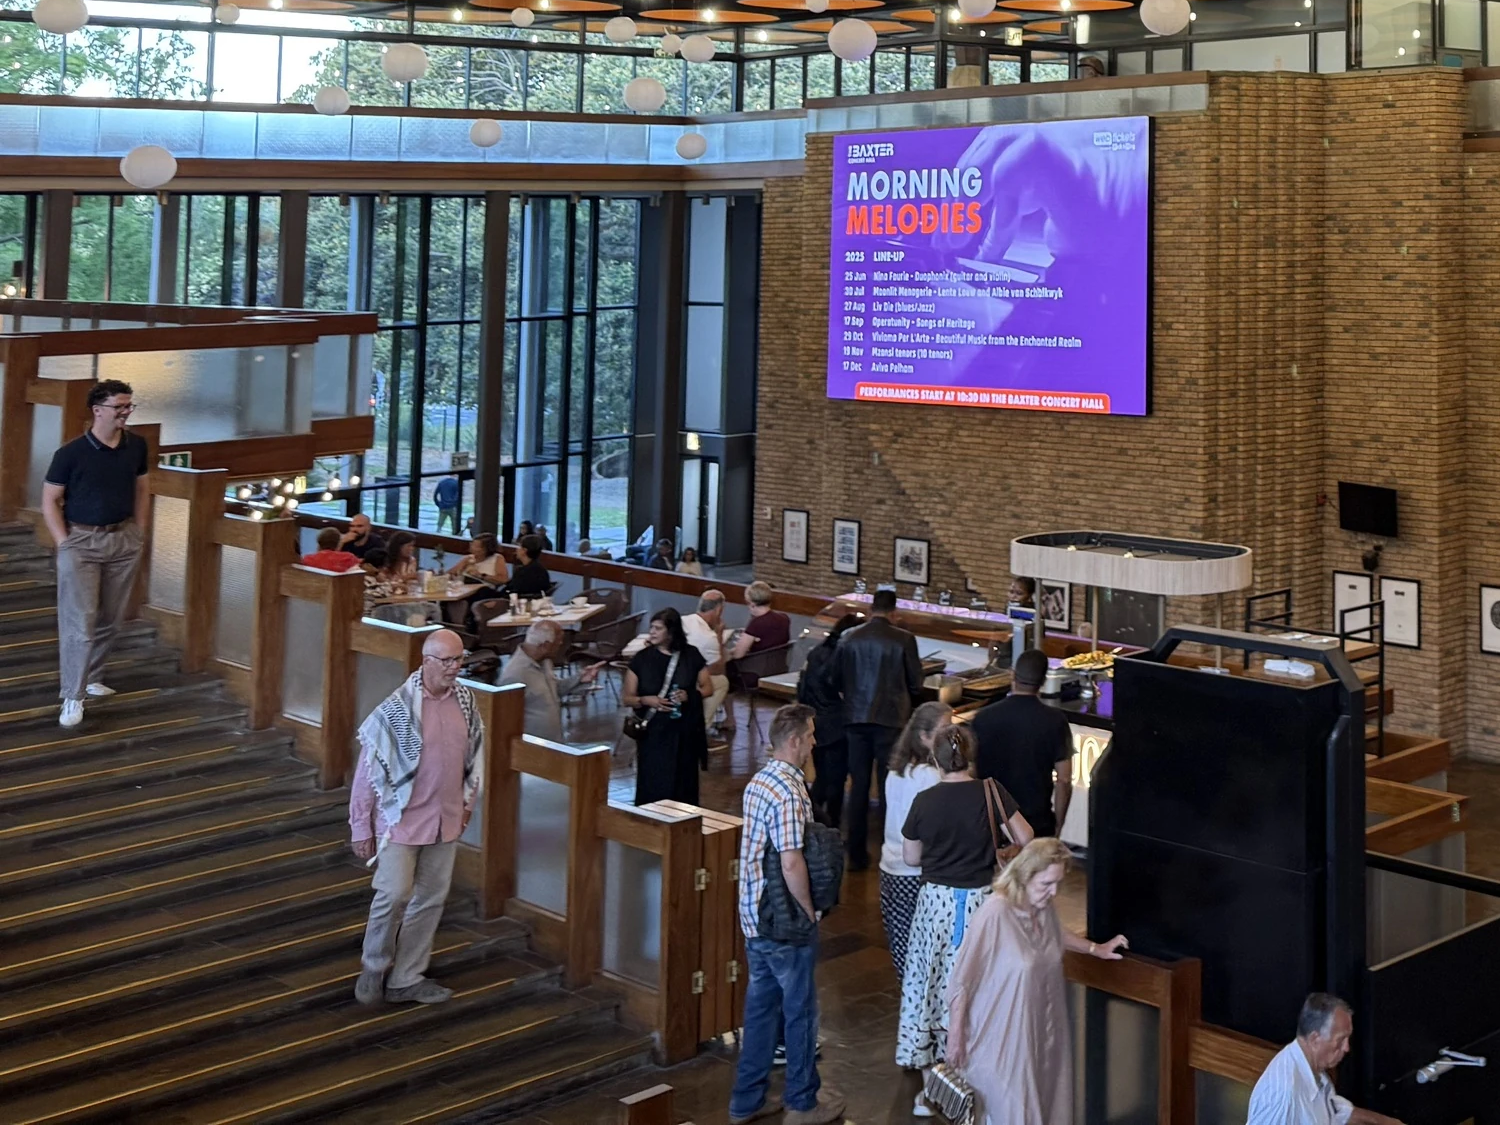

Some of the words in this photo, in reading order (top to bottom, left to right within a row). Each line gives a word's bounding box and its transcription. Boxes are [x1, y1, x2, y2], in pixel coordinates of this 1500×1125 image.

[852, 143, 894, 158] BAXTER
[847, 167, 982, 201] MORNING
[846, 201, 982, 235] MELODIES
[845, 251, 865, 262] 2025
[873, 251, 905, 262] LINE-UP
[845, 271, 854, 281] 25
[854, 271, 866, 281] Jun
[889, 271, 909, 281] Fourie
[975, 271, 988, 282] and
[854, 286, 865, 296] Jul
[873, 286, 897, 296] Moonlit
[898, 286, 932, 298] Menagerie
[977, 287, 991, 297] and
[992, 286, 1009, 297] Albie
[1010, 288, 1024, 298] van
[844, 301, 853, 311] 27
[853, 301, 865, 313] Aug
[872, 301, 882, 311] Liv
[844, 316, 851, 326] 17
[851, 316, 864, 327] Sep
[916, 317, 936, 329] Songs
[937, 317, 946, 327] of
[946, 318, 976, 330] Heritage
[852, 331, 863, 341] Oct
[898, 332, 909, 343] Per
[936, 333, 967, 344] Beautiful
[967, 334, 987, 345] Music
[988, 334, 1005, 345] from
[1006, 335, 1018, 346] the
[1020, 335, 1057, 347] Enchanted
[1058, 336, 1082, 348] Realm
[851, 346, 863, 356] Nov
[871, 347, 894, 357] Mzansi
[895, 347, 916, 358] tenors
[928, 348, 953, 360] tenors)
[843, 361, 850, 371] 17
[850, 361, 862, 371] Dec
[871, 362, 889, 372] Aviva
[889, 362, 914, 373] Pelham
[860, 386, 919, 399] PERFORMANCES
[920, 389, 944, 400] START
[944, 391, 956, 401] AT
[957, 391, 979, 403] 10:30
[979, 392, 990, 403] IN
[991, 393, 1007, 404] THE
[1007, 394, 1040, 406] BAXTER
[1041, 396, 1080, 408] CONCERT
[1081, 398, 1104, 409] HALL
